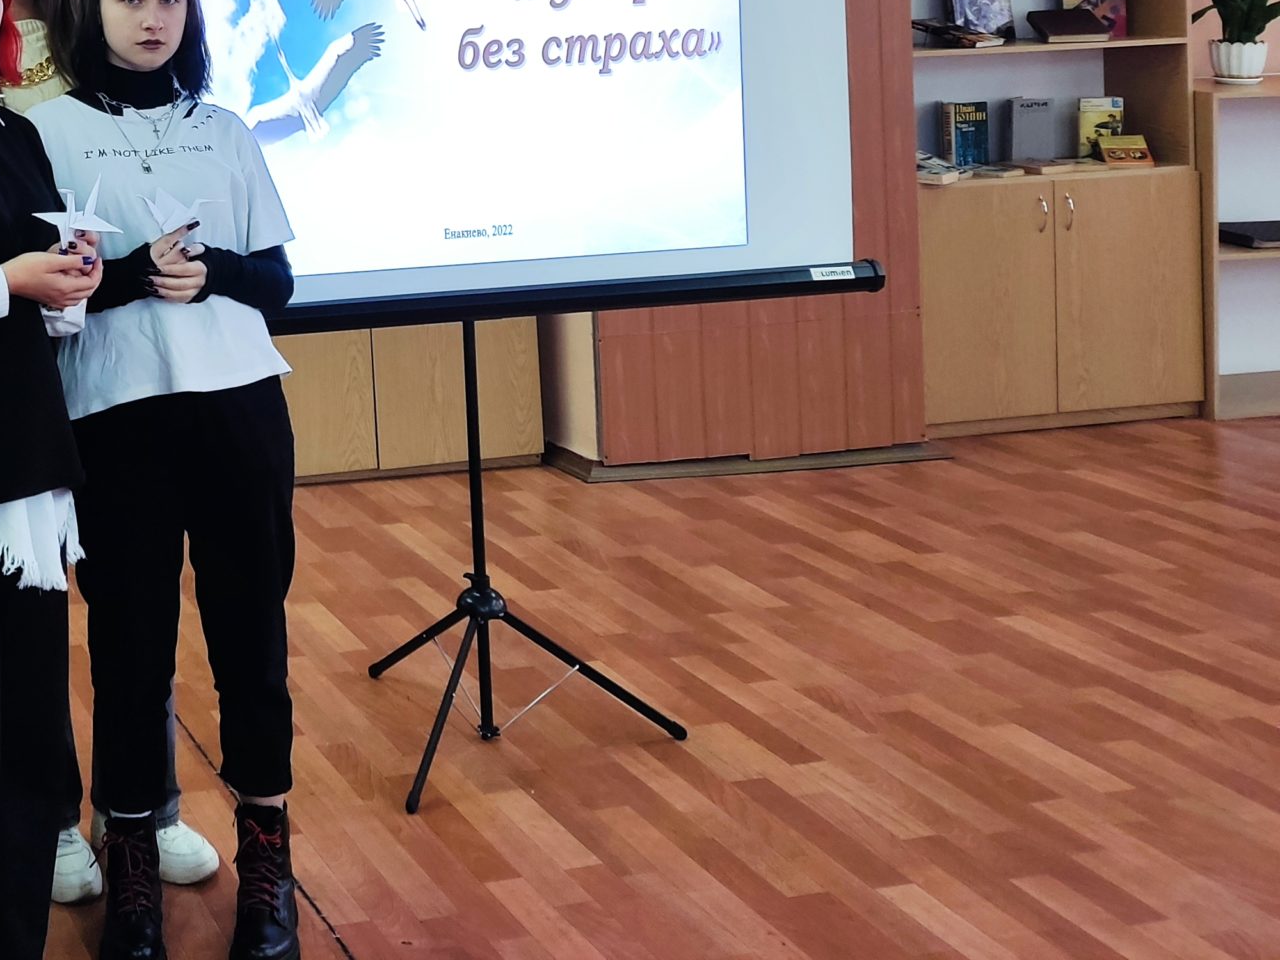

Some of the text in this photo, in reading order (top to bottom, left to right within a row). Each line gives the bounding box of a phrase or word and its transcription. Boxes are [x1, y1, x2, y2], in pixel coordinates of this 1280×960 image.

[458, 24, 721, 75] без страха»
[112, 149, 140, 158] NOT
[145, 147, 175, 158] LIKE
[179, 144, 213, 153] THEM
[444, 224, 513, 240] Енакиево, 2022
